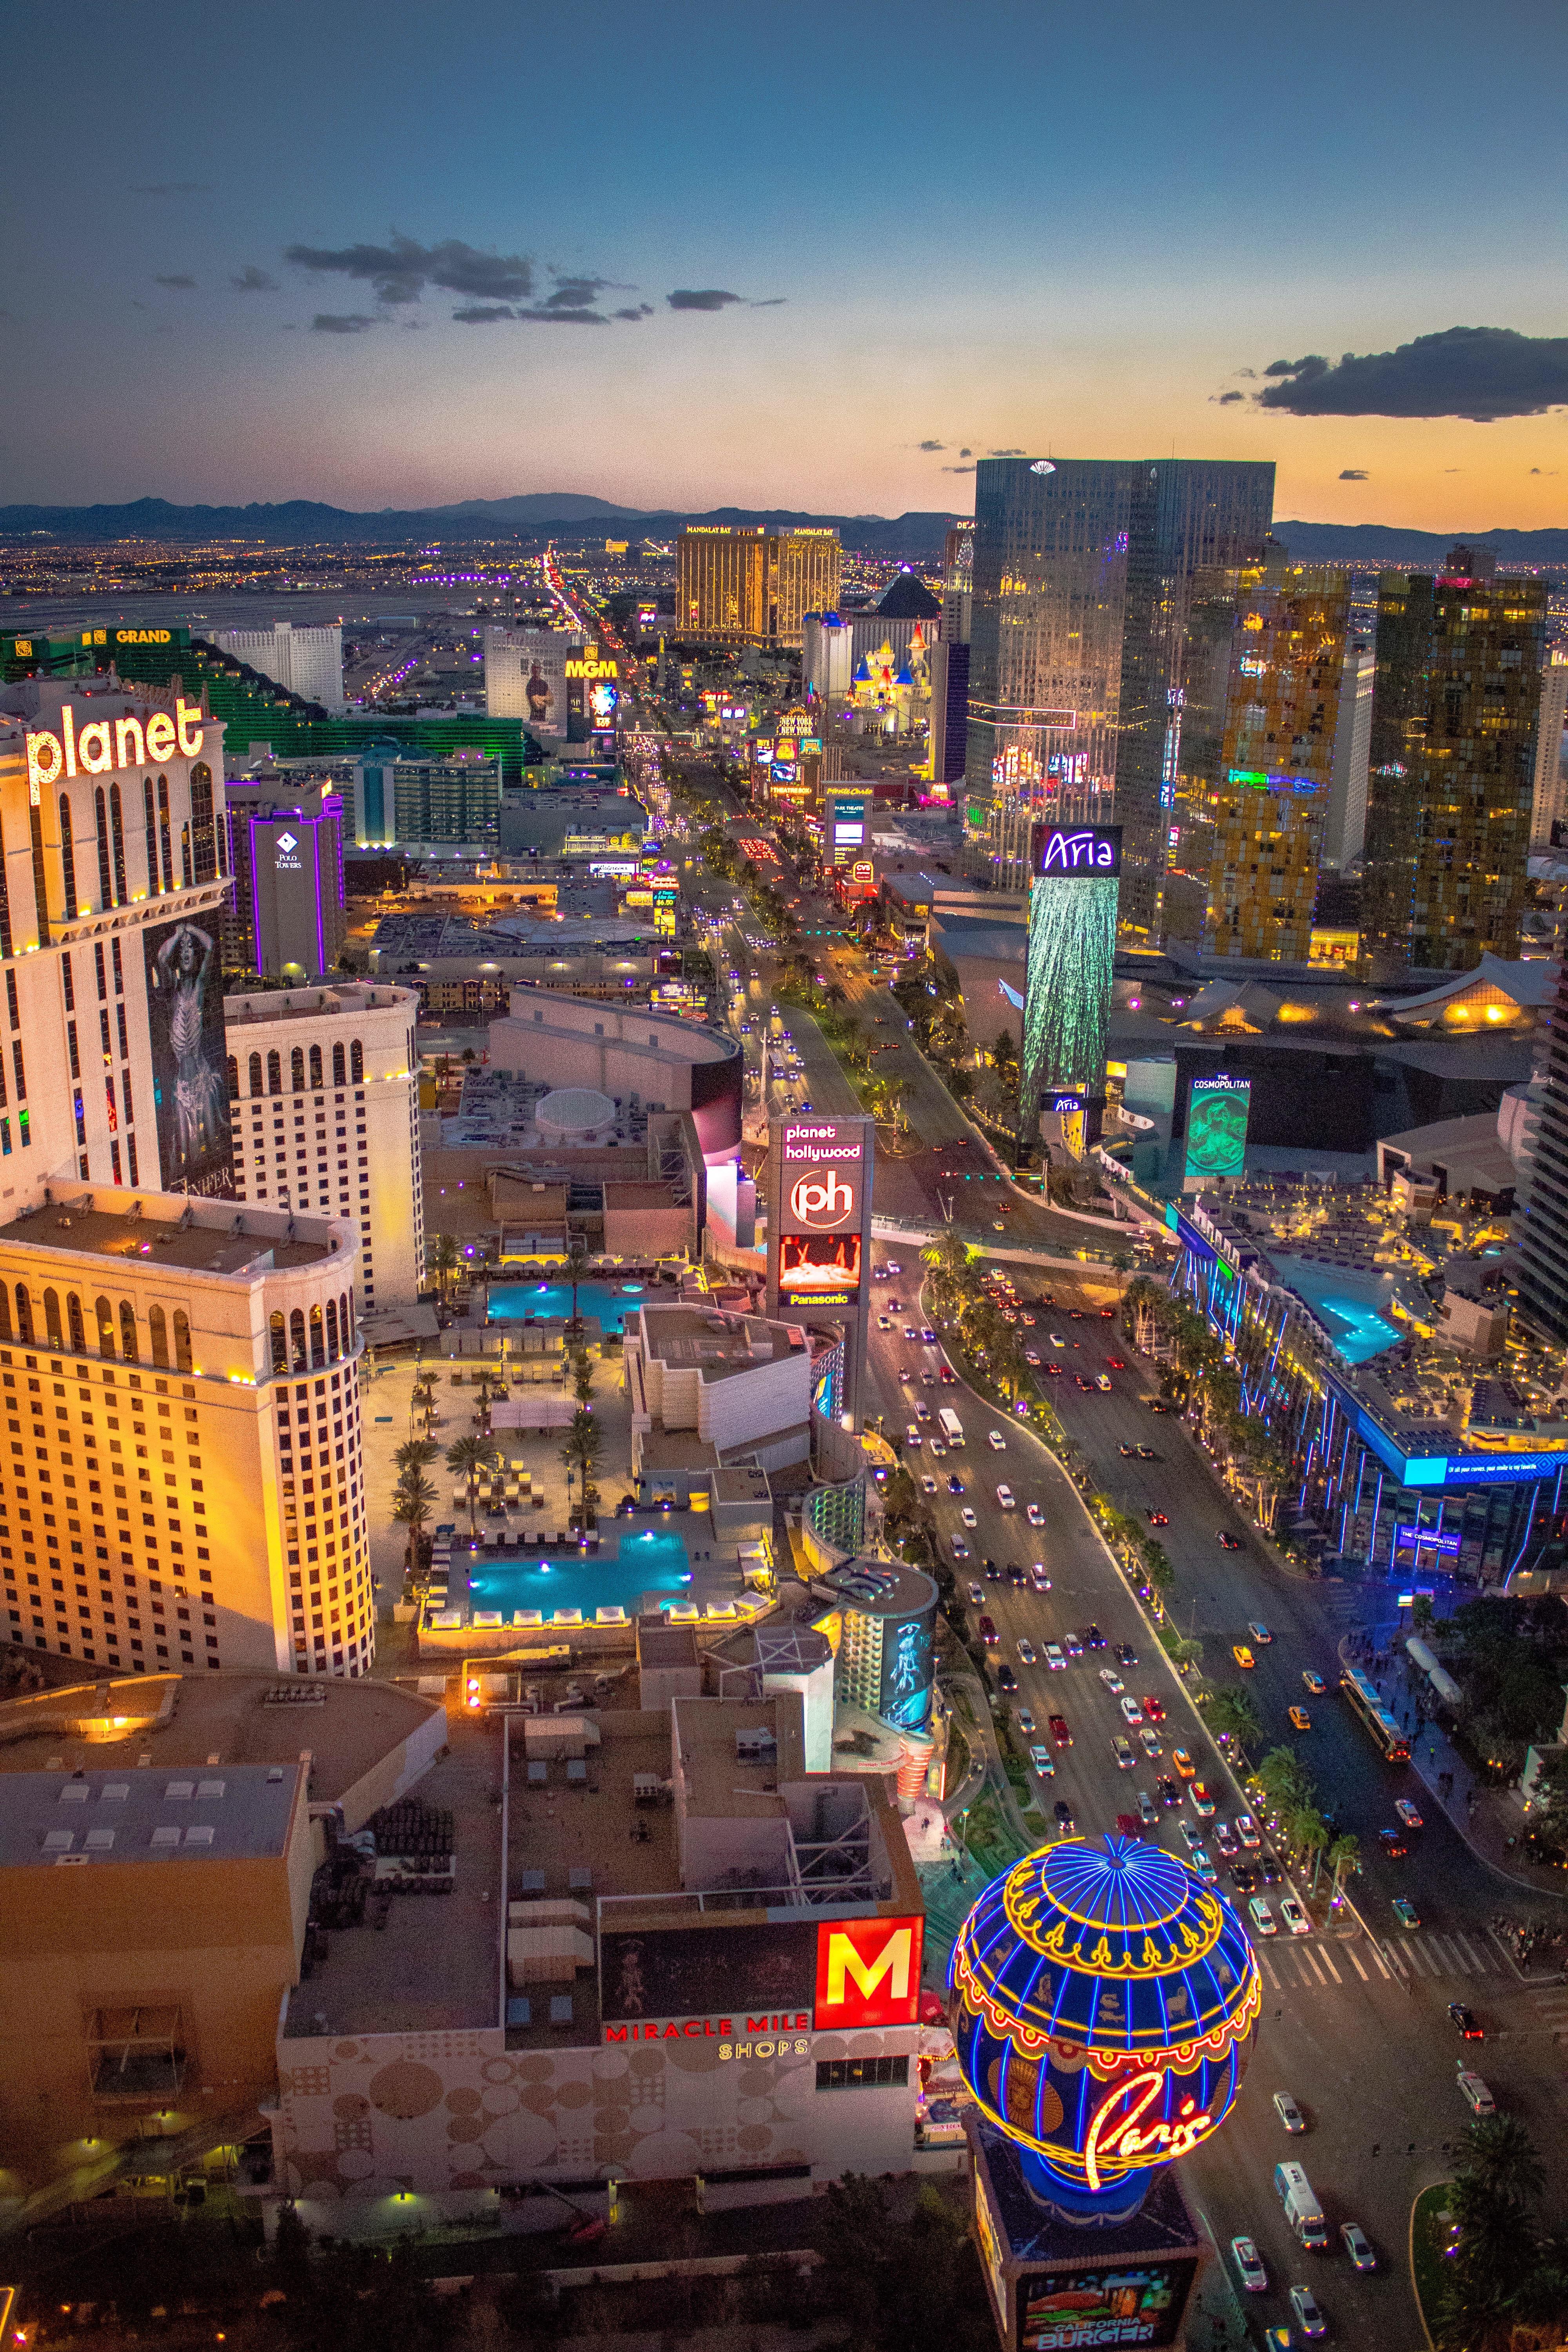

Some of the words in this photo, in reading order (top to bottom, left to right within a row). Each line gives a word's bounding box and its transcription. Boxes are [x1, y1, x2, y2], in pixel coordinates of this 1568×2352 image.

[116, 630, 171, 643] GRAND
[565, 660, 617, 678] MGM
[26, 698, 204, 806] planet
[1045, 832, 1112, 868] Aria
[1194, 1080, 1250, 1089] COSMOPOLITAN
[1055, 1099, 1079, 1111] Aria
[786, 1125, 835, 1142] planet
[786, 1145, 860, 1161] hollywood
[798, 1170, 853, 1221] ph
[790, 1294, 848, 1305] Panasonic
[1414, 1534, 1457, 1546] COSMOPOLITAN
[827, 1928, 912, 2004] M
[606, 2018, 732, 2042] MIRACLE
[747, 2013, 808, 2033] MILE
[718, 2039, 808, 2060] SHOPS
[1085, 2070, 1211, 2190] Paris
[1054, 2317, 1141, 2332] CALIFORNIA
[1037, 2323, 1154, 2351] BURGER
